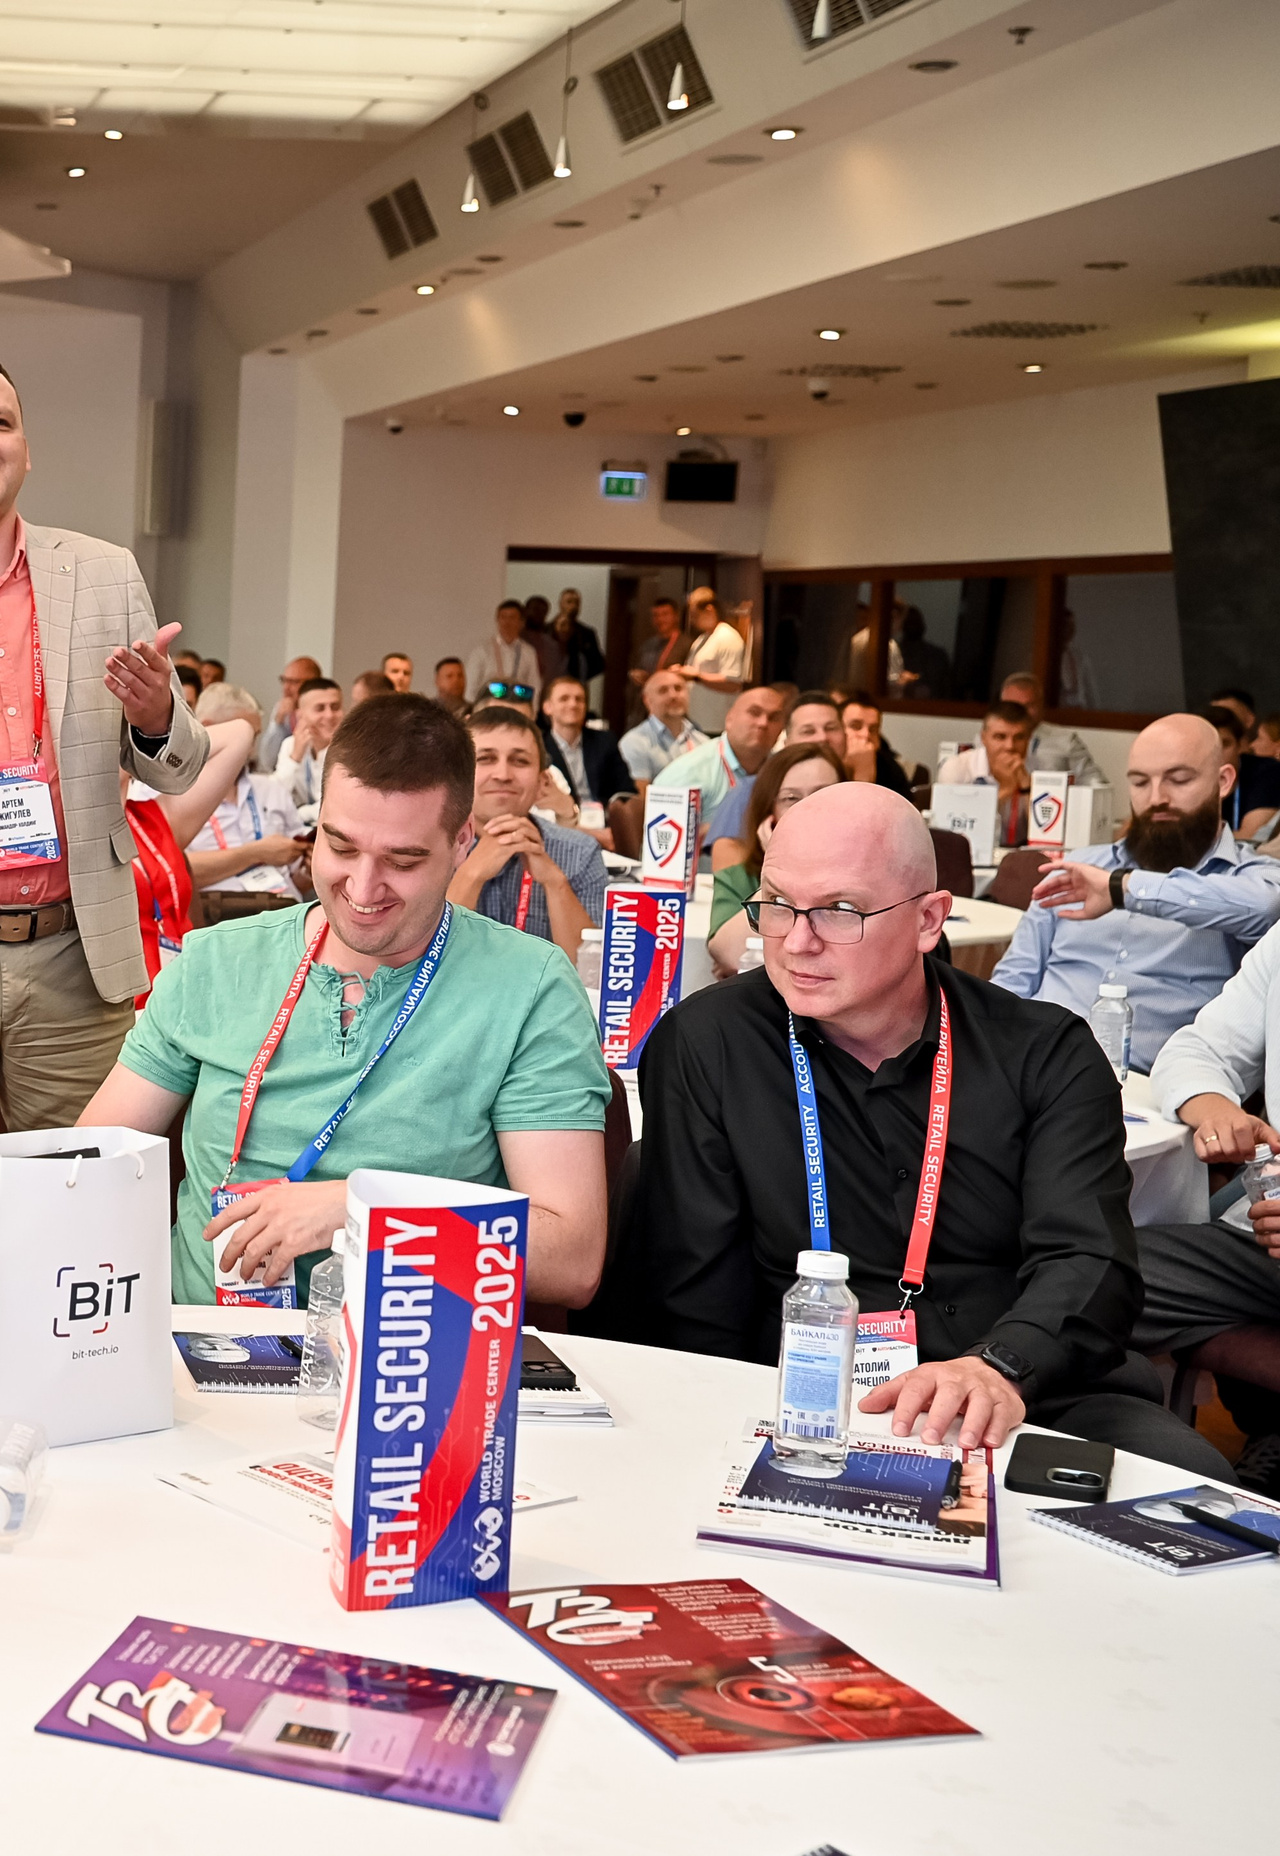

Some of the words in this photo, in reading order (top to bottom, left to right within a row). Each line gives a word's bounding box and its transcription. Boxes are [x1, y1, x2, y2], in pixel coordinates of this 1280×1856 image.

[33, 648, 42, 698] SECURITY
[3, 764, 39, 778] SECURITY
[2, 798, 24, 809] АРТЕМ
[45, 841, 57, 859] 2025
[608, 894, 639, 991] SECURITY
[655, 898, 681, 950] 2025
[286, 943, 316, 1000] РИТЕЙЛА
[264, 1008, 290, 1047] RETAIL
[385, 960, 435, 1046] АССОЦИАЦИЯ
[604, 995, 633, 1065] RETAIL
[243, 1049, 270, 1110] SECURITY
[935, 1031, 951, 1094] РИТЕЙЛА
[802, 1105, 821, 1175] SECURITY
[929, 1104, 945, 1152] RETAIL
[814, 1177, 825, 1228] RETAIL
[918, 1155, 939, 1226] SECURITY
[69, 1273, 140, 1321] BiT
[472, 1215, 519, 1332] 2025
[374, 1216, 438, 1433] SECURITY
[857, 1320, 906, 1336] SECURITY
[72, 1345, 119, 1360] bit-tech.io
[486, 1339, 500, 1396] CENTER
[854, 1359, 890, 1374] АТОЛИЙ
[852, 1375, 890, 1387] ЗНЕЦОВ
[483, 1399, 497, 1449] TRADE
[480, 1451, 493, 1503] WORLD
[492, 1436, 505, 1501] MOSCOW
[363, 1442, 422, 1597] RETAIL
[823, 1522, 971, 1545] ДИРЕКТОР
